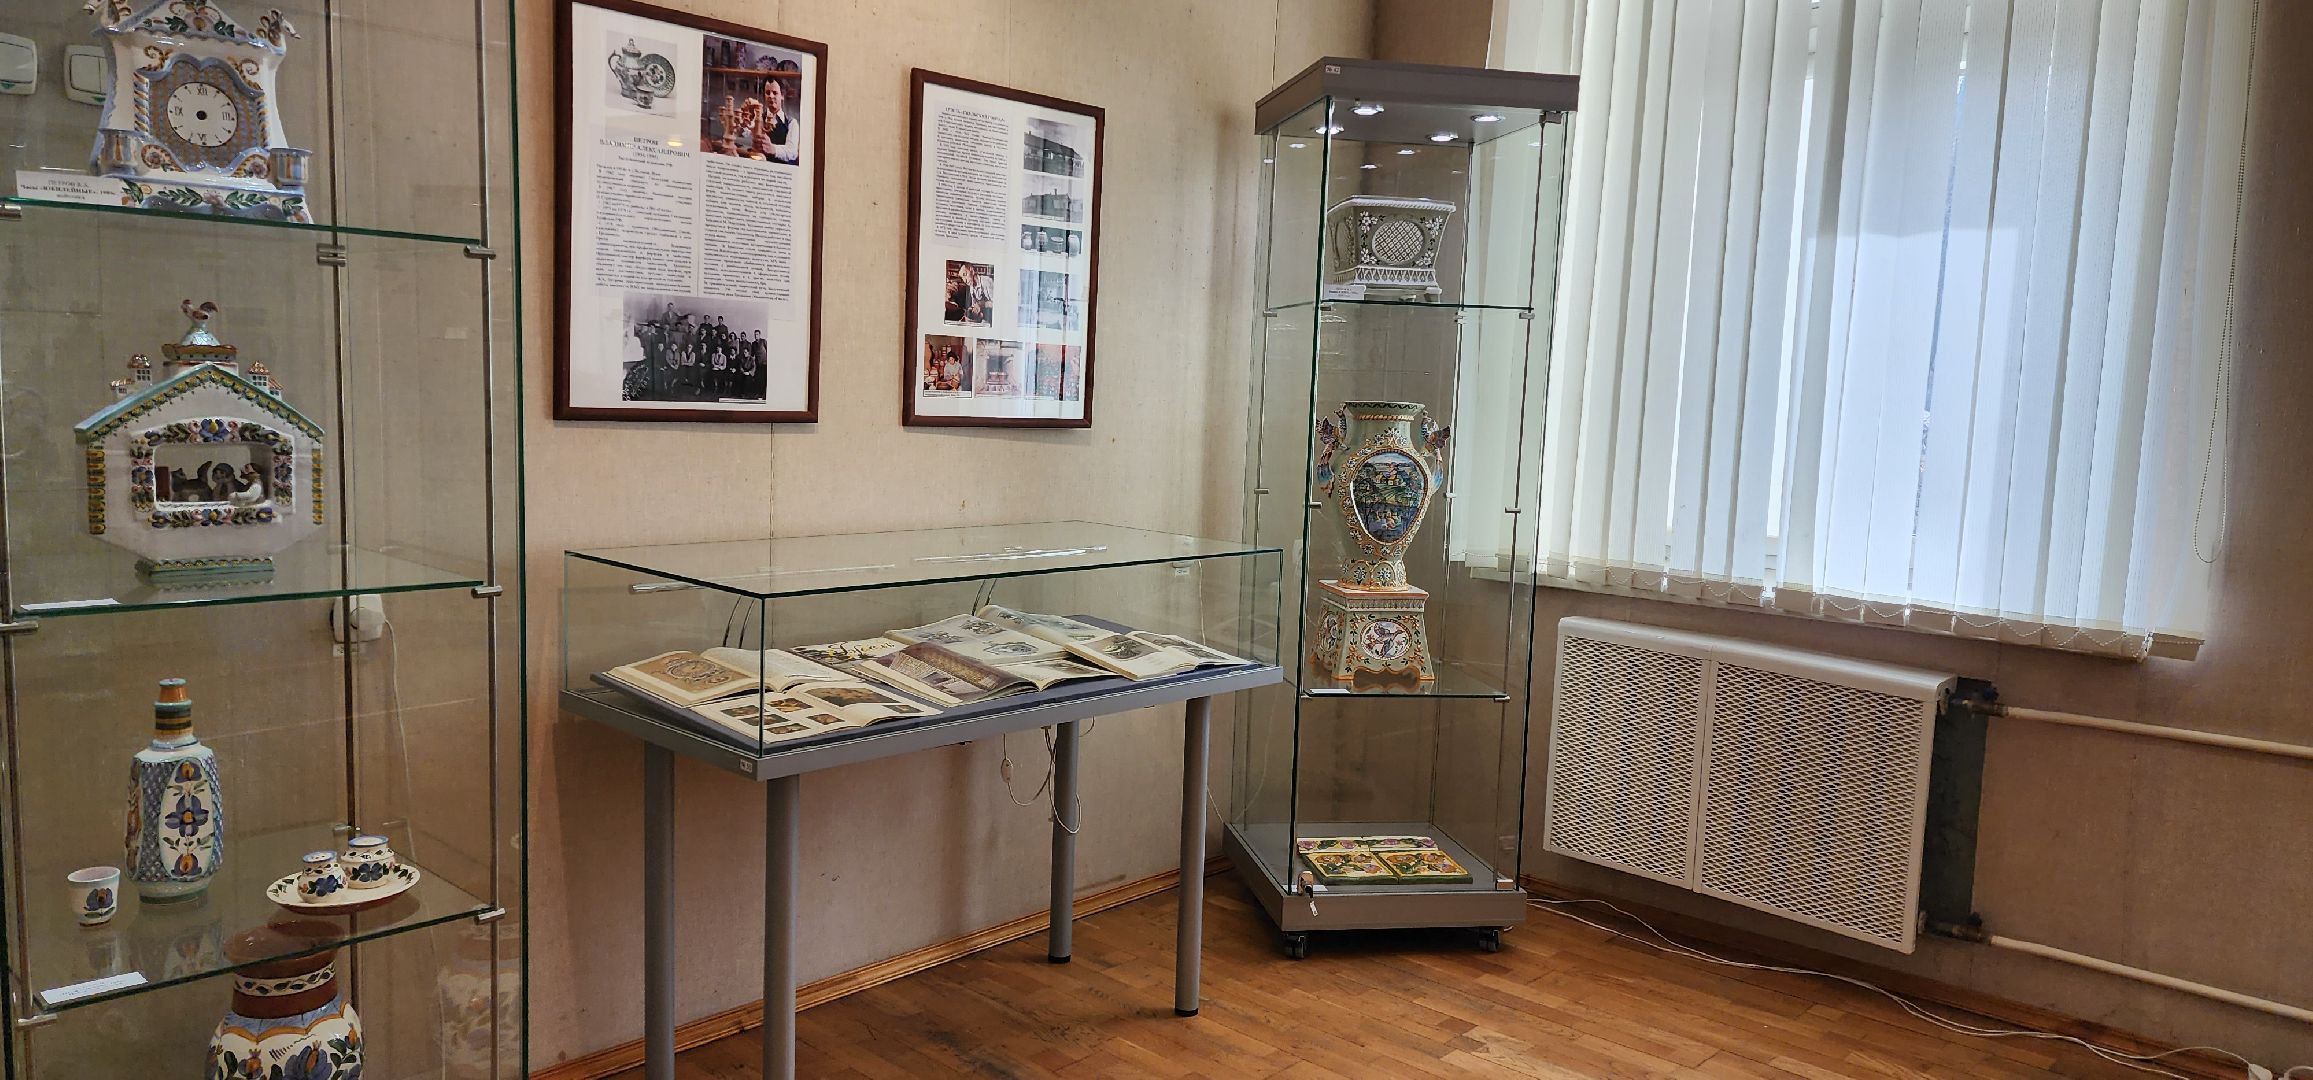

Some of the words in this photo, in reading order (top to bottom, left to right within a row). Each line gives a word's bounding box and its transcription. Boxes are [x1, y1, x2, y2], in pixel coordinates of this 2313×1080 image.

[197, 86, 208, 96] XII
[174, 106, 184, 116] IX
[222, 111, 231, 121] III
